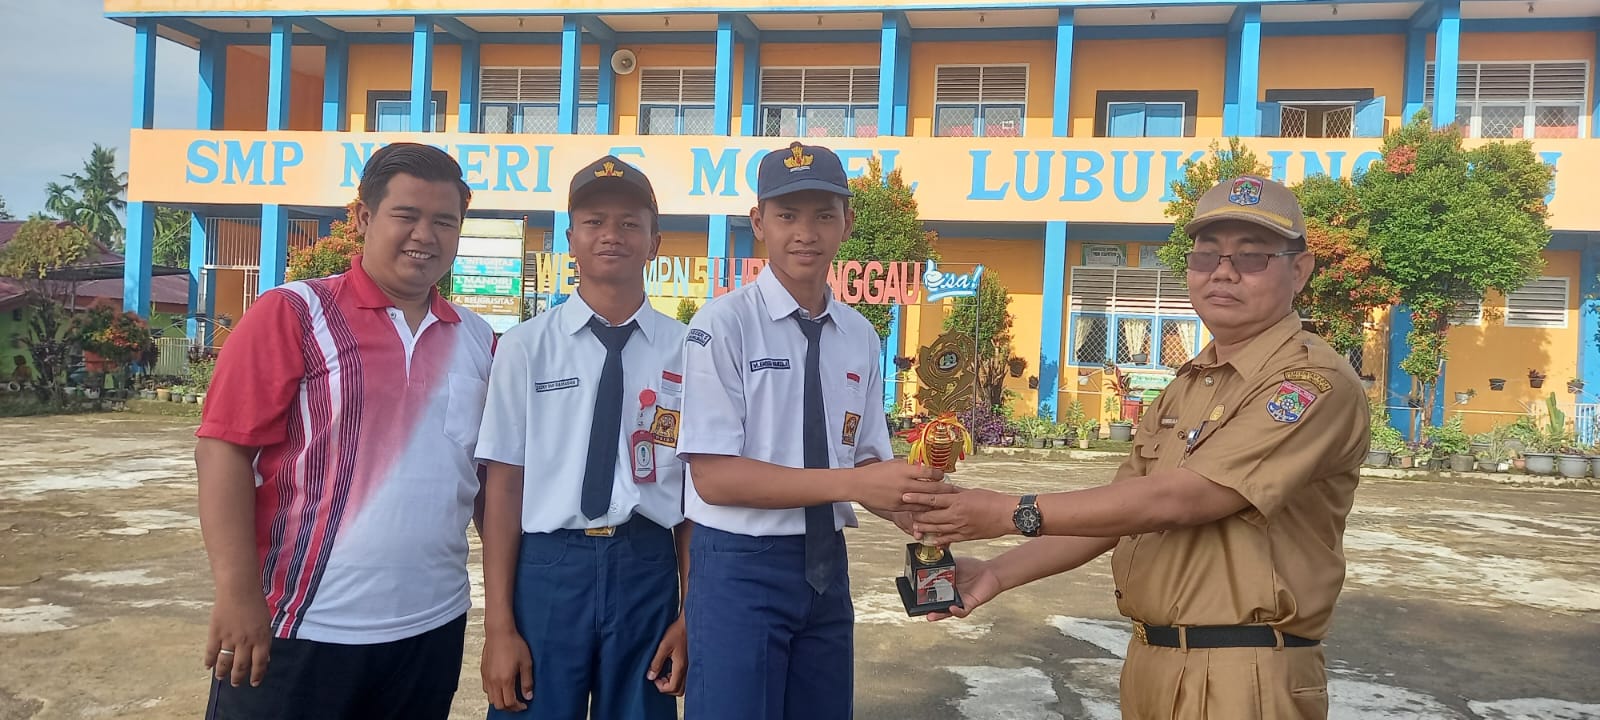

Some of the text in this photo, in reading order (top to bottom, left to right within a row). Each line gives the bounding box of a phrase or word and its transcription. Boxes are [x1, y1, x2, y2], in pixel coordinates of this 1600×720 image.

[186, 139, 304, 186] SMP
[340, 142, 554, 193] NERI
[643, 256, 690, 297] MPN
[694, 257, 708, 298] 5
